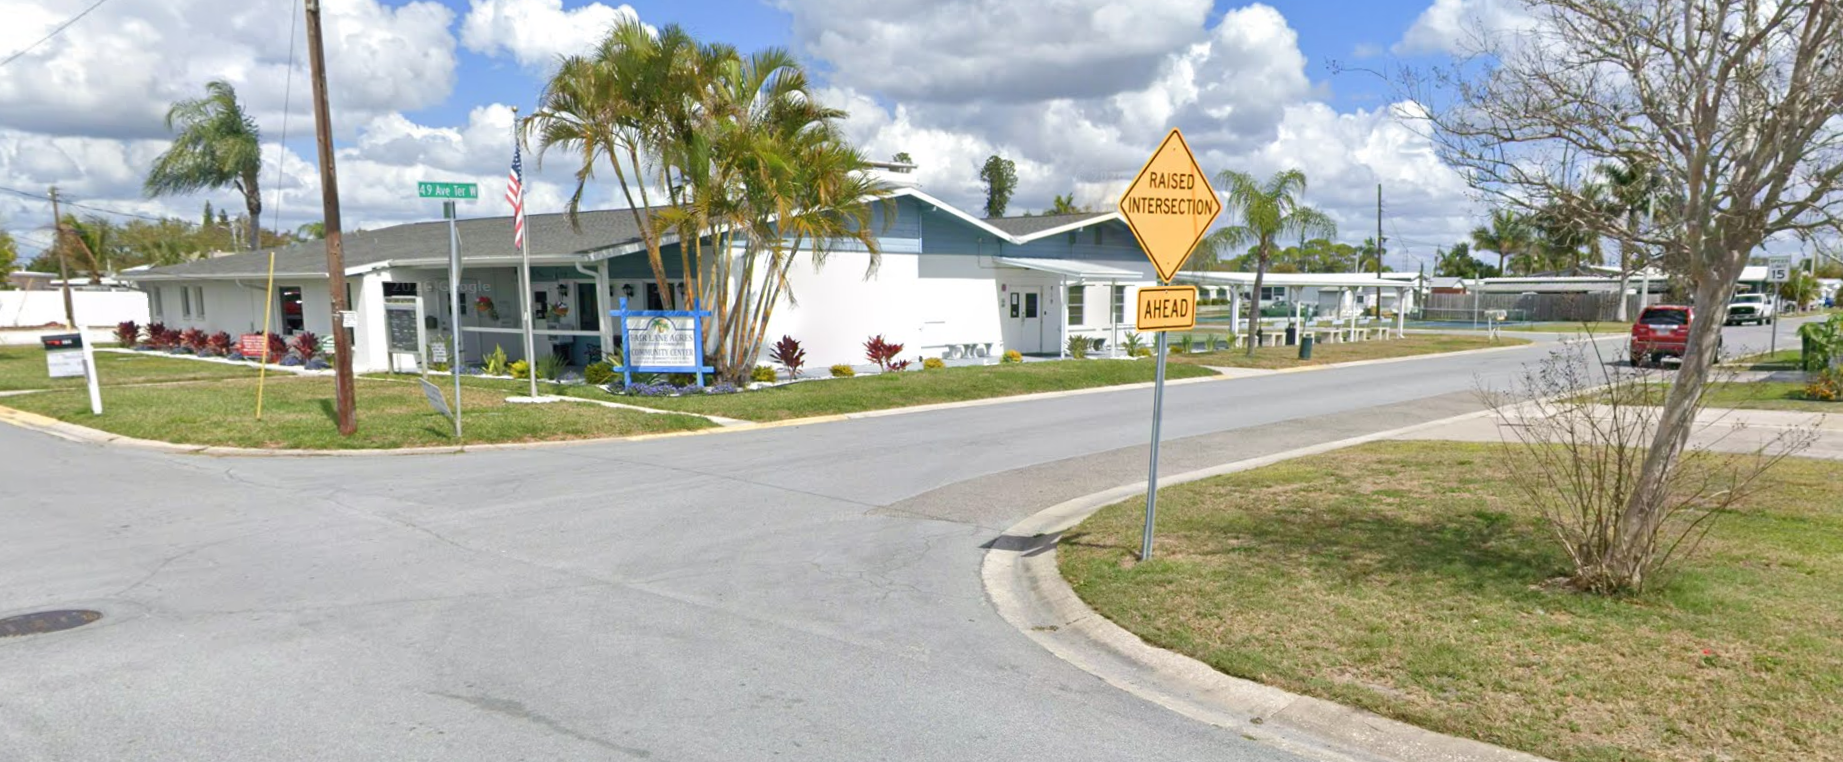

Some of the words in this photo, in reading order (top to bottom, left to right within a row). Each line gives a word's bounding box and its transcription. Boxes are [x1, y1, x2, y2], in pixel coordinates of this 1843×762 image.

[1149, 171, 1195, 190] RAISED
[419, 184, 432, 196] 49
[435, 184, 451, 196] Ave
[453, 185, 466, 197] Ter
[469, 185, 477, 197] W
[1128, 197, 1213, 215] INTERSECTION
[1772, 269, 1785, 279] 15
[1144, 299, 1188, 319] AHEAD
[649, 334, 669, 342] LANE
[671, 334, 693, 342] ACRES
[632, 349, 668, 357] COMMUNITY
[670, 349, 693, 357] CENTER
